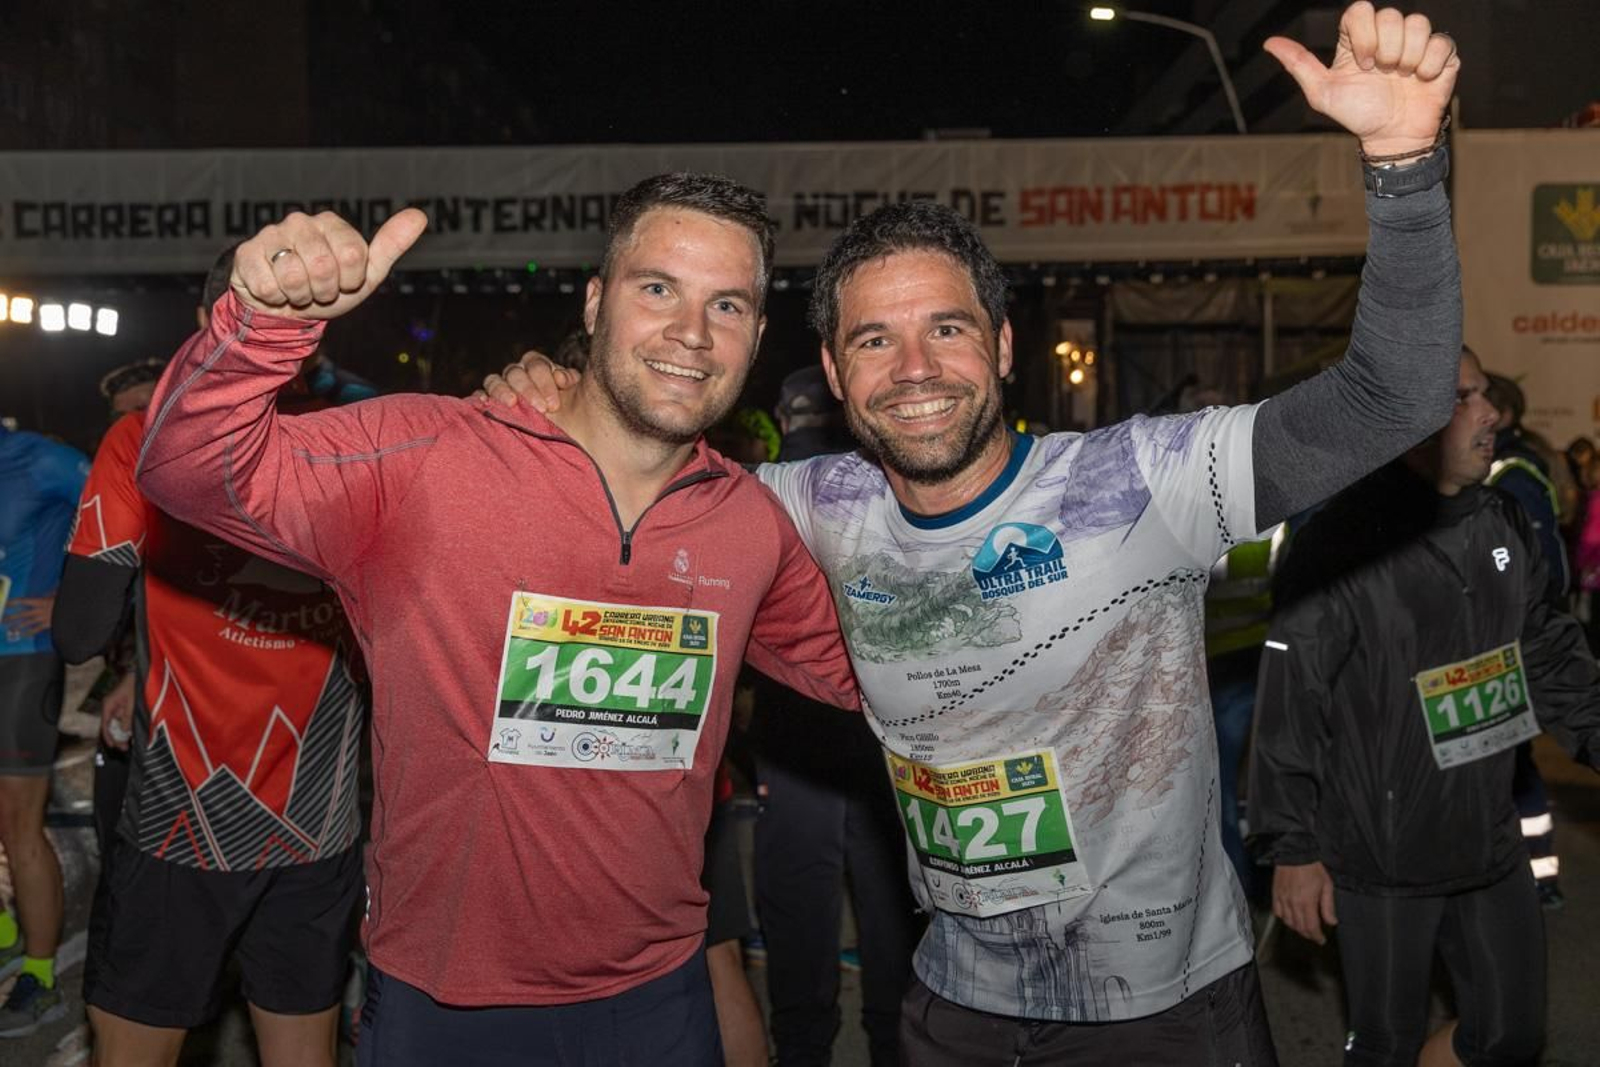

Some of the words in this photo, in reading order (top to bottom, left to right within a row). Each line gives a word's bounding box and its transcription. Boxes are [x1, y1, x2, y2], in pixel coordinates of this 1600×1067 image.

[13, 200, 212, 239] CARRERA
[951, 188, 1005, 226] DE
[1018, 186, 1102, 228] SAN
[1111, 182, 1257, 224] ANTON
[698, 575, 730, 590] Running
[979, 572, 1023, 591] ULTRA
[1026, 559, 1067, 580] TRAIL
[981, 585, 1026, 600] BOSQUES
[1029, 579, 1046, 590] DEL
[1048, 571, 1069, 583] SUR
[561, 608, 602, 636] 42
[603, 610, 641, 620] CARRERA
[642, 613, 675, 623] URBANA
[219, 627, 295, 650] Atletismo
[599, 625, 625, 637] SAN
[628, 627, 674, 642] ANTON
[526, 646, 698, 709] 1644
[906, 671, 933, 681] Pollos
[934, 669, 945, 677] de
[945, 667, 957, 676] La
[958, 664, 982, 674] Mesa
[1445, 667, 1468, 686] 42
[932, 679, 960, 689] 1700m
[1437, 672, 1520, 728] 1126
[555, 708, 586, 720] PEDRO
[588, 710, 624, 723] JIMÉNEZ
[626, 714, 658, 725] ALCALÁ
[960, 764, 996, 777] URBANA
[953, 779, 1000, 797] ANTON
[906, 797, 1046, 861] 1427
[994, 858, 1029, 871] ALCALÁ
[1100, 911, 1131, 925] Iglesia
[1131, 910, 1143, 919] de
[1145, 907, 1172, 917] Santa
[1139, 920, 1165, 930] 800m
